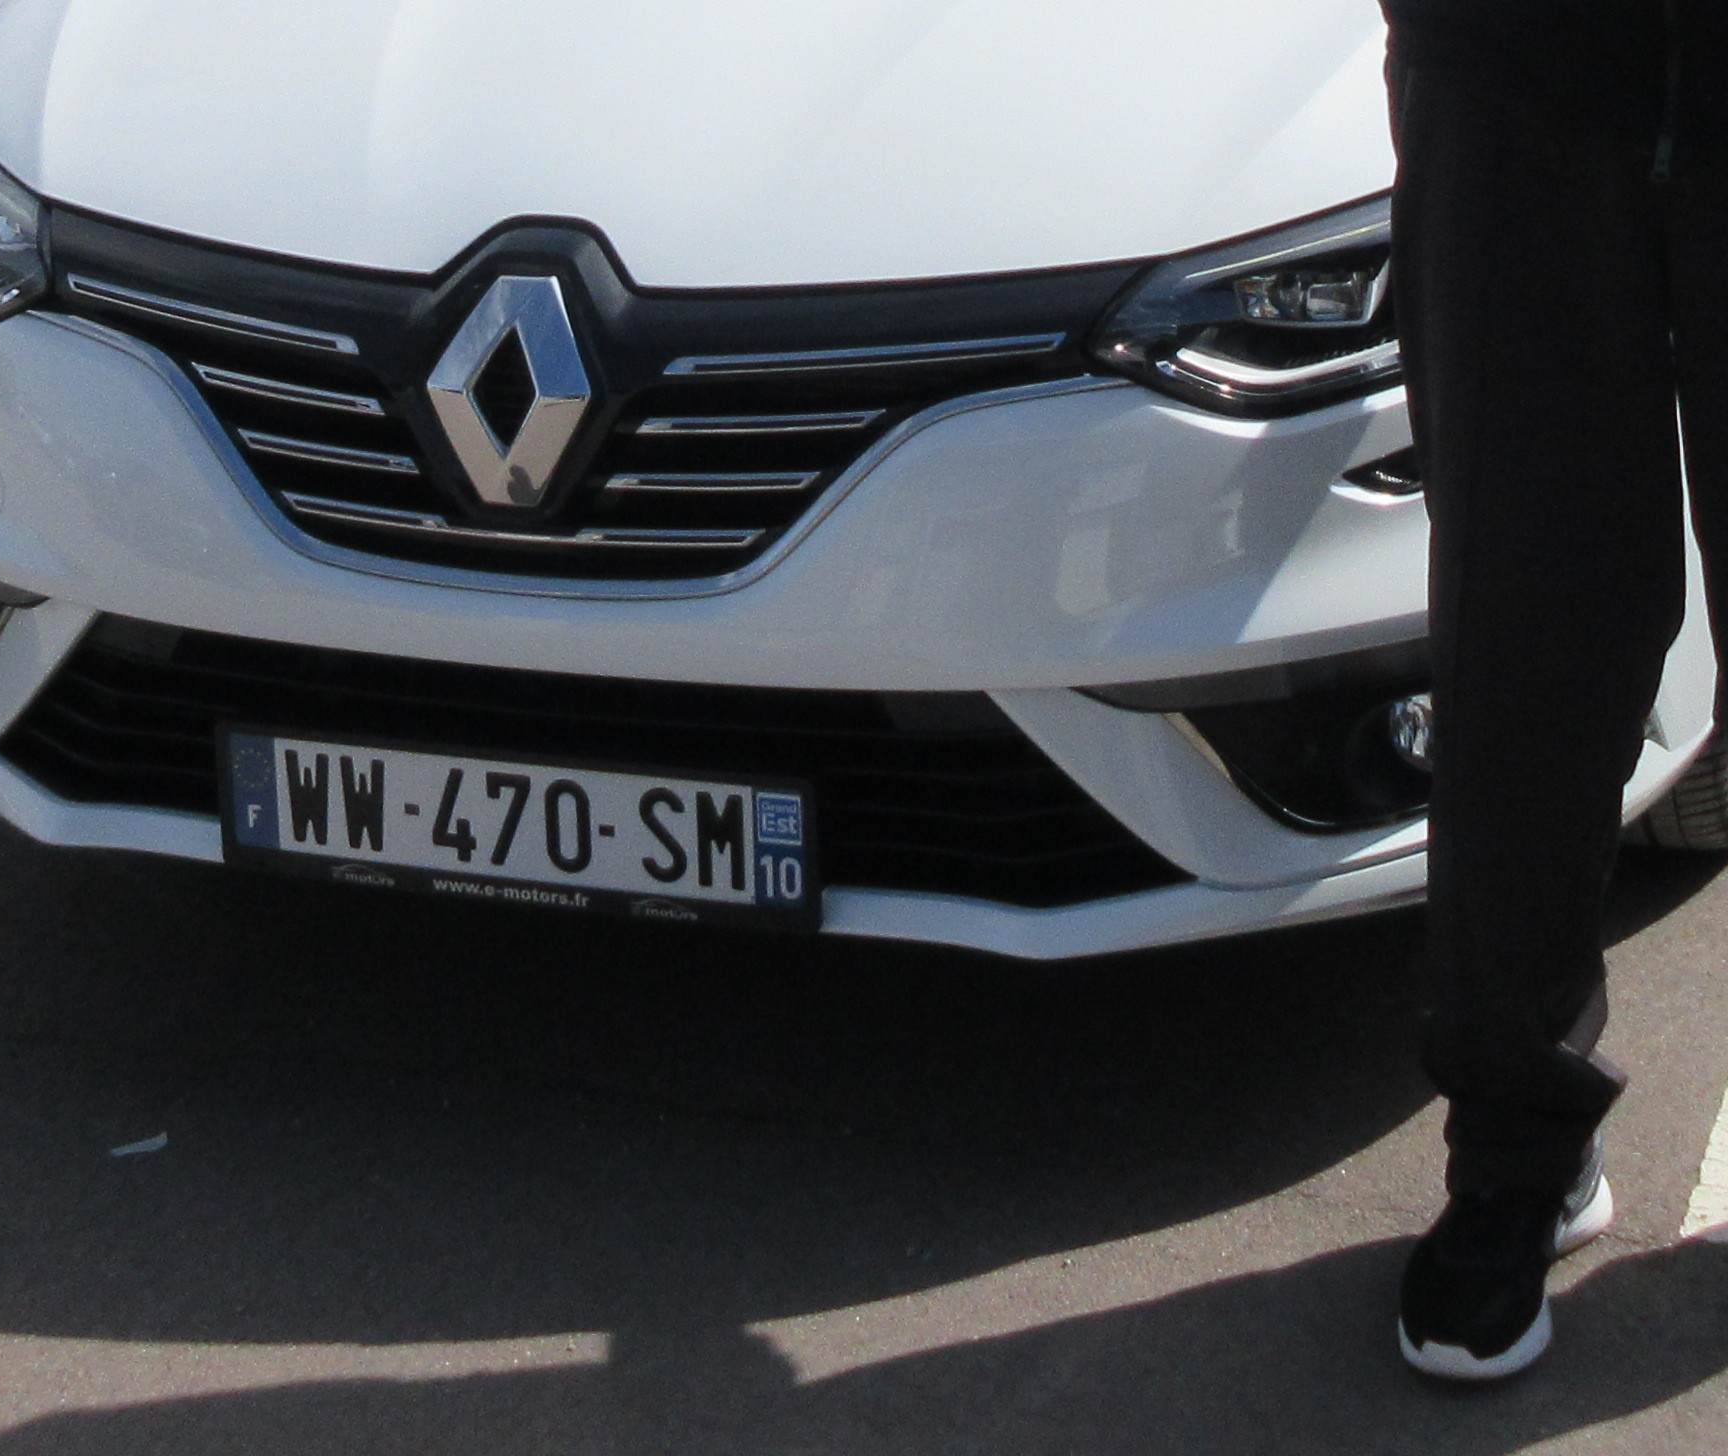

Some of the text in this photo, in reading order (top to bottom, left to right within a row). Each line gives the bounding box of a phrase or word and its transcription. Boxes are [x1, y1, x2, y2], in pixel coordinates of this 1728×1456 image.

[247, 804, 262, 828] F
[285, 749, 747, 891] WW-470-SM
[762, 812, 798, 834] Est
[759, 854, 802, 899] 10
[432, 878, 589, 907] www.e-motors.fr
